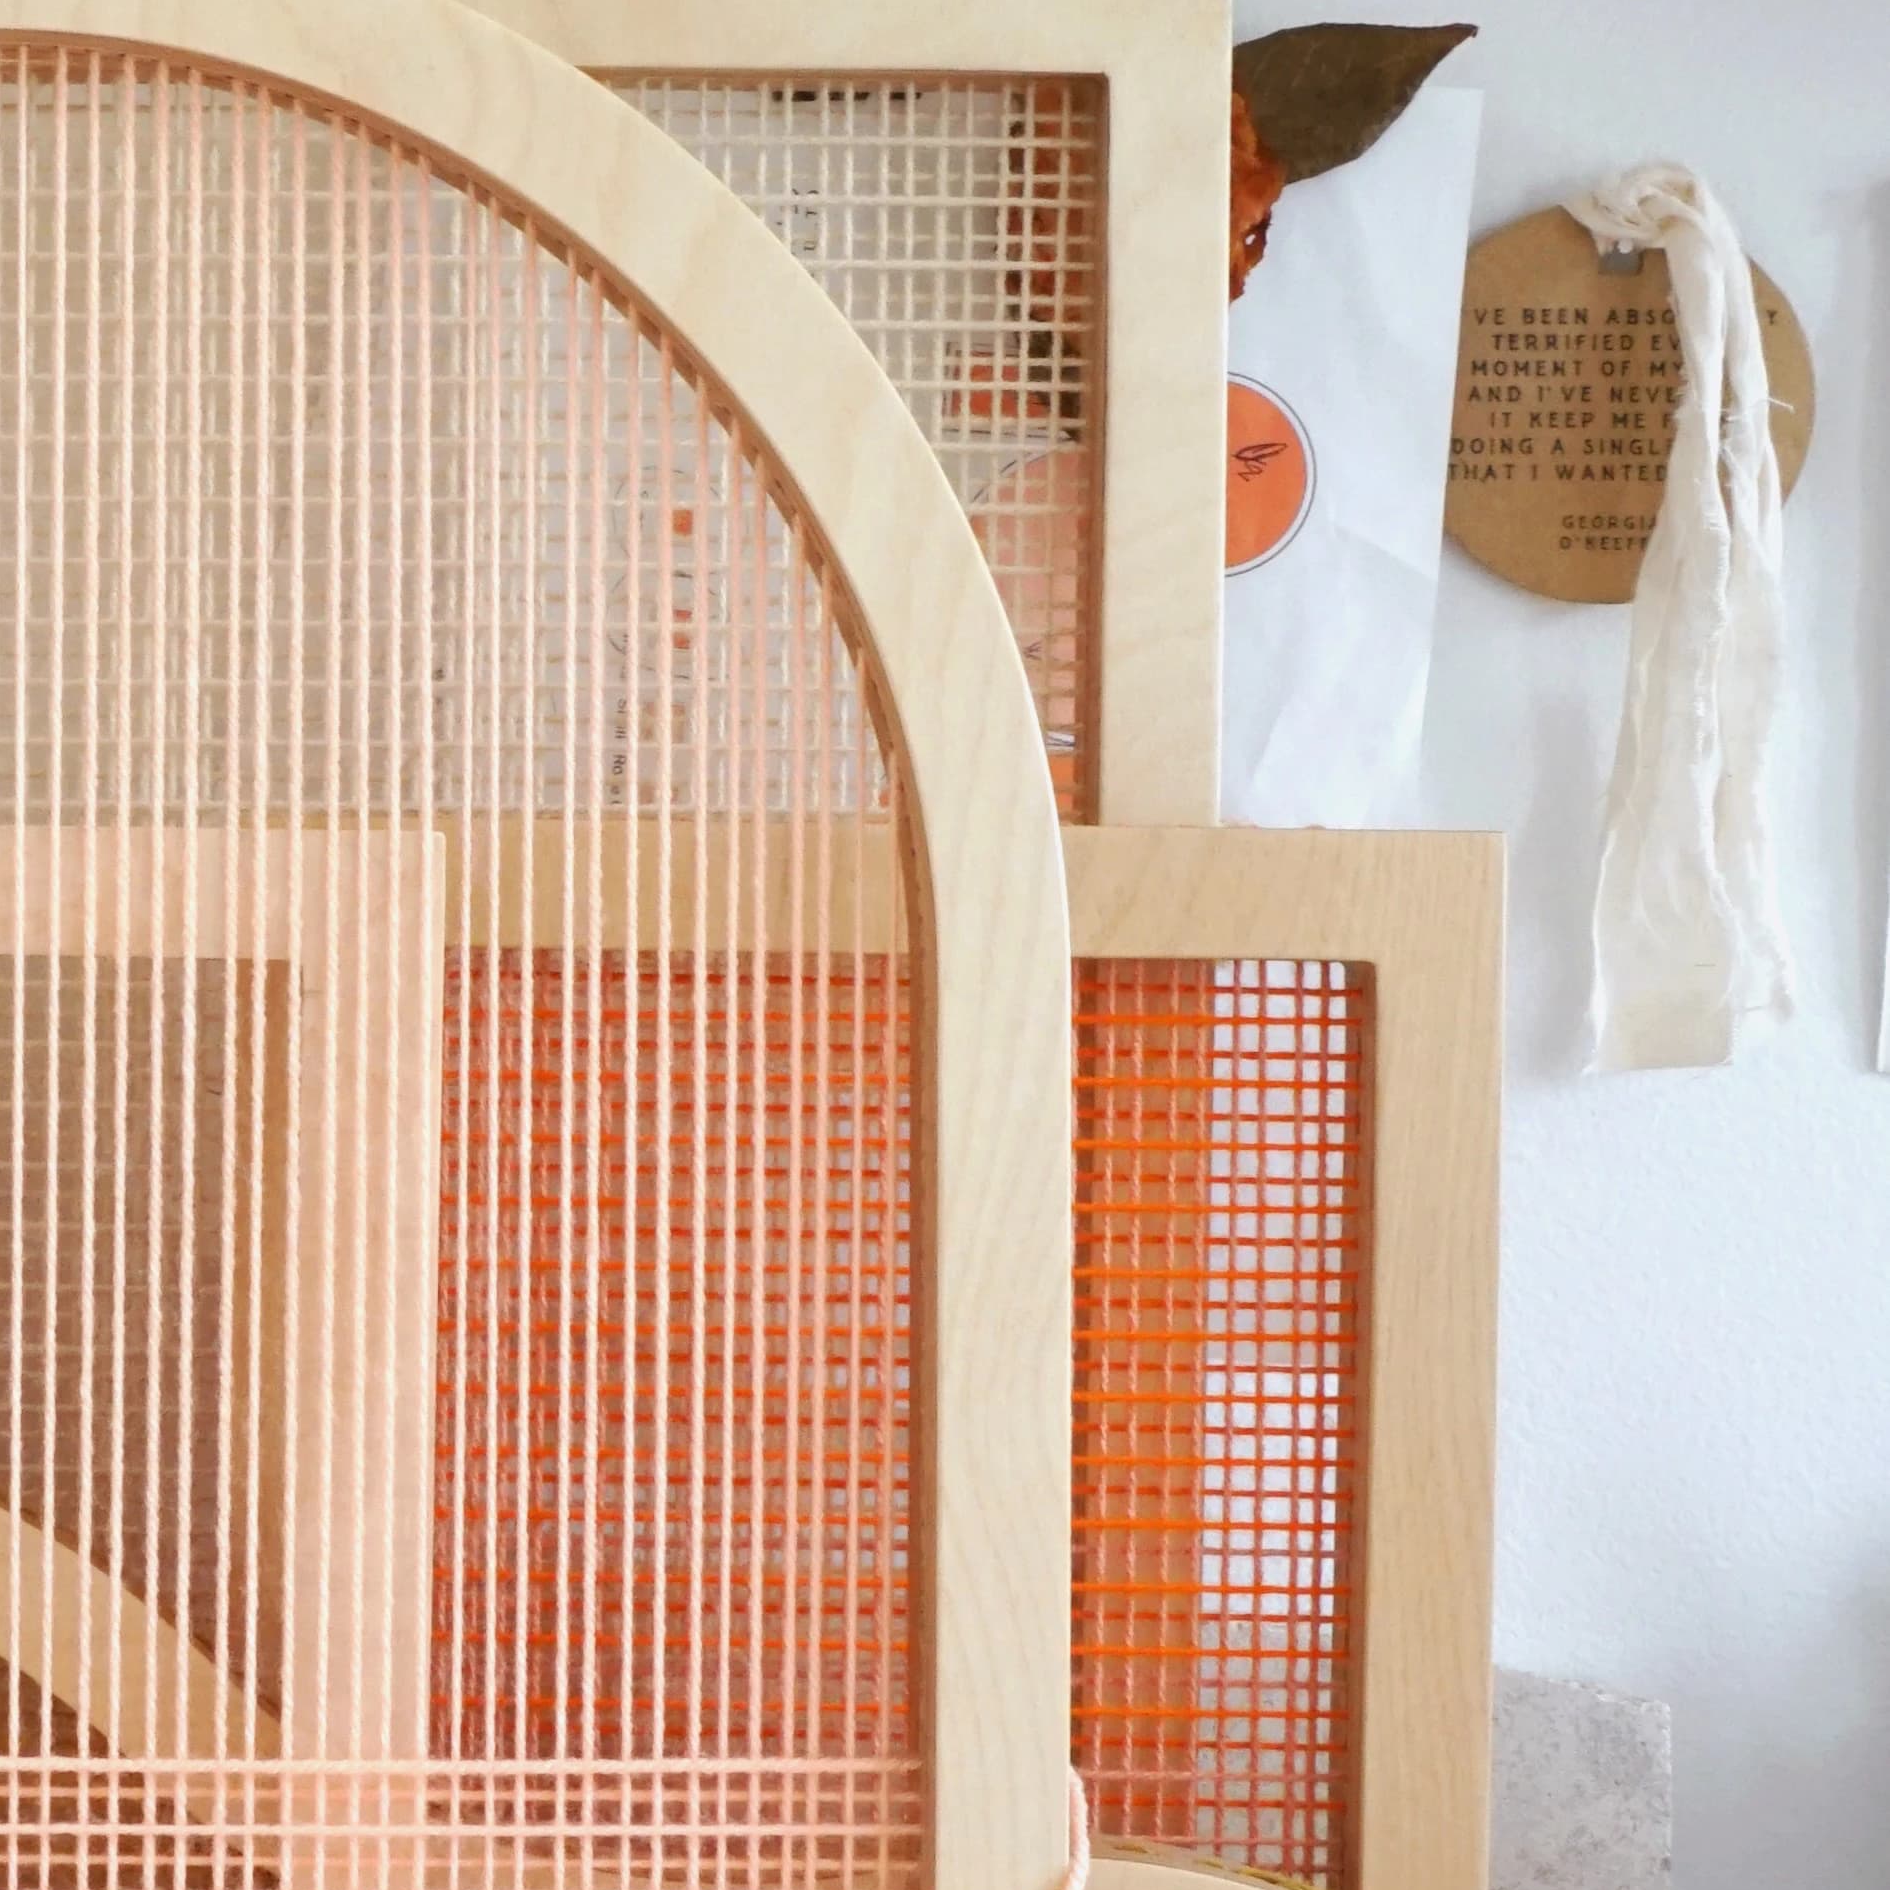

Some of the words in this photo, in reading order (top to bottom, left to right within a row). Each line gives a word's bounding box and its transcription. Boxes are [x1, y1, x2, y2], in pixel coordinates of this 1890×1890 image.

[1522, 308, 1588, 325] BEEN
[1491, 333, 1635, 351] TERRIFIED
[1470, 360, 1584, 377] MOMENT
[1600, 360, 1631, 377] OF
[1649, 360, 1685, 378] MY
[1468, 385, 1522, 402] AND
[1537, 385, 1592, 402] I'VE
[1610, 385, 1677, 403] NEVE
[1488, 412, 1512, 428] IT
[1528, 411, 1595, 428] KEEP
[1611, 412, 1646, 429] ME
[1451, 437, 1533, 455] DOING
[1550, 438, 1566, 455] A
[1448, 463, 1515, 482] THAT
[1530, 464, 1539, 481] I
[1555, 463, 1667, 482] WANTED
